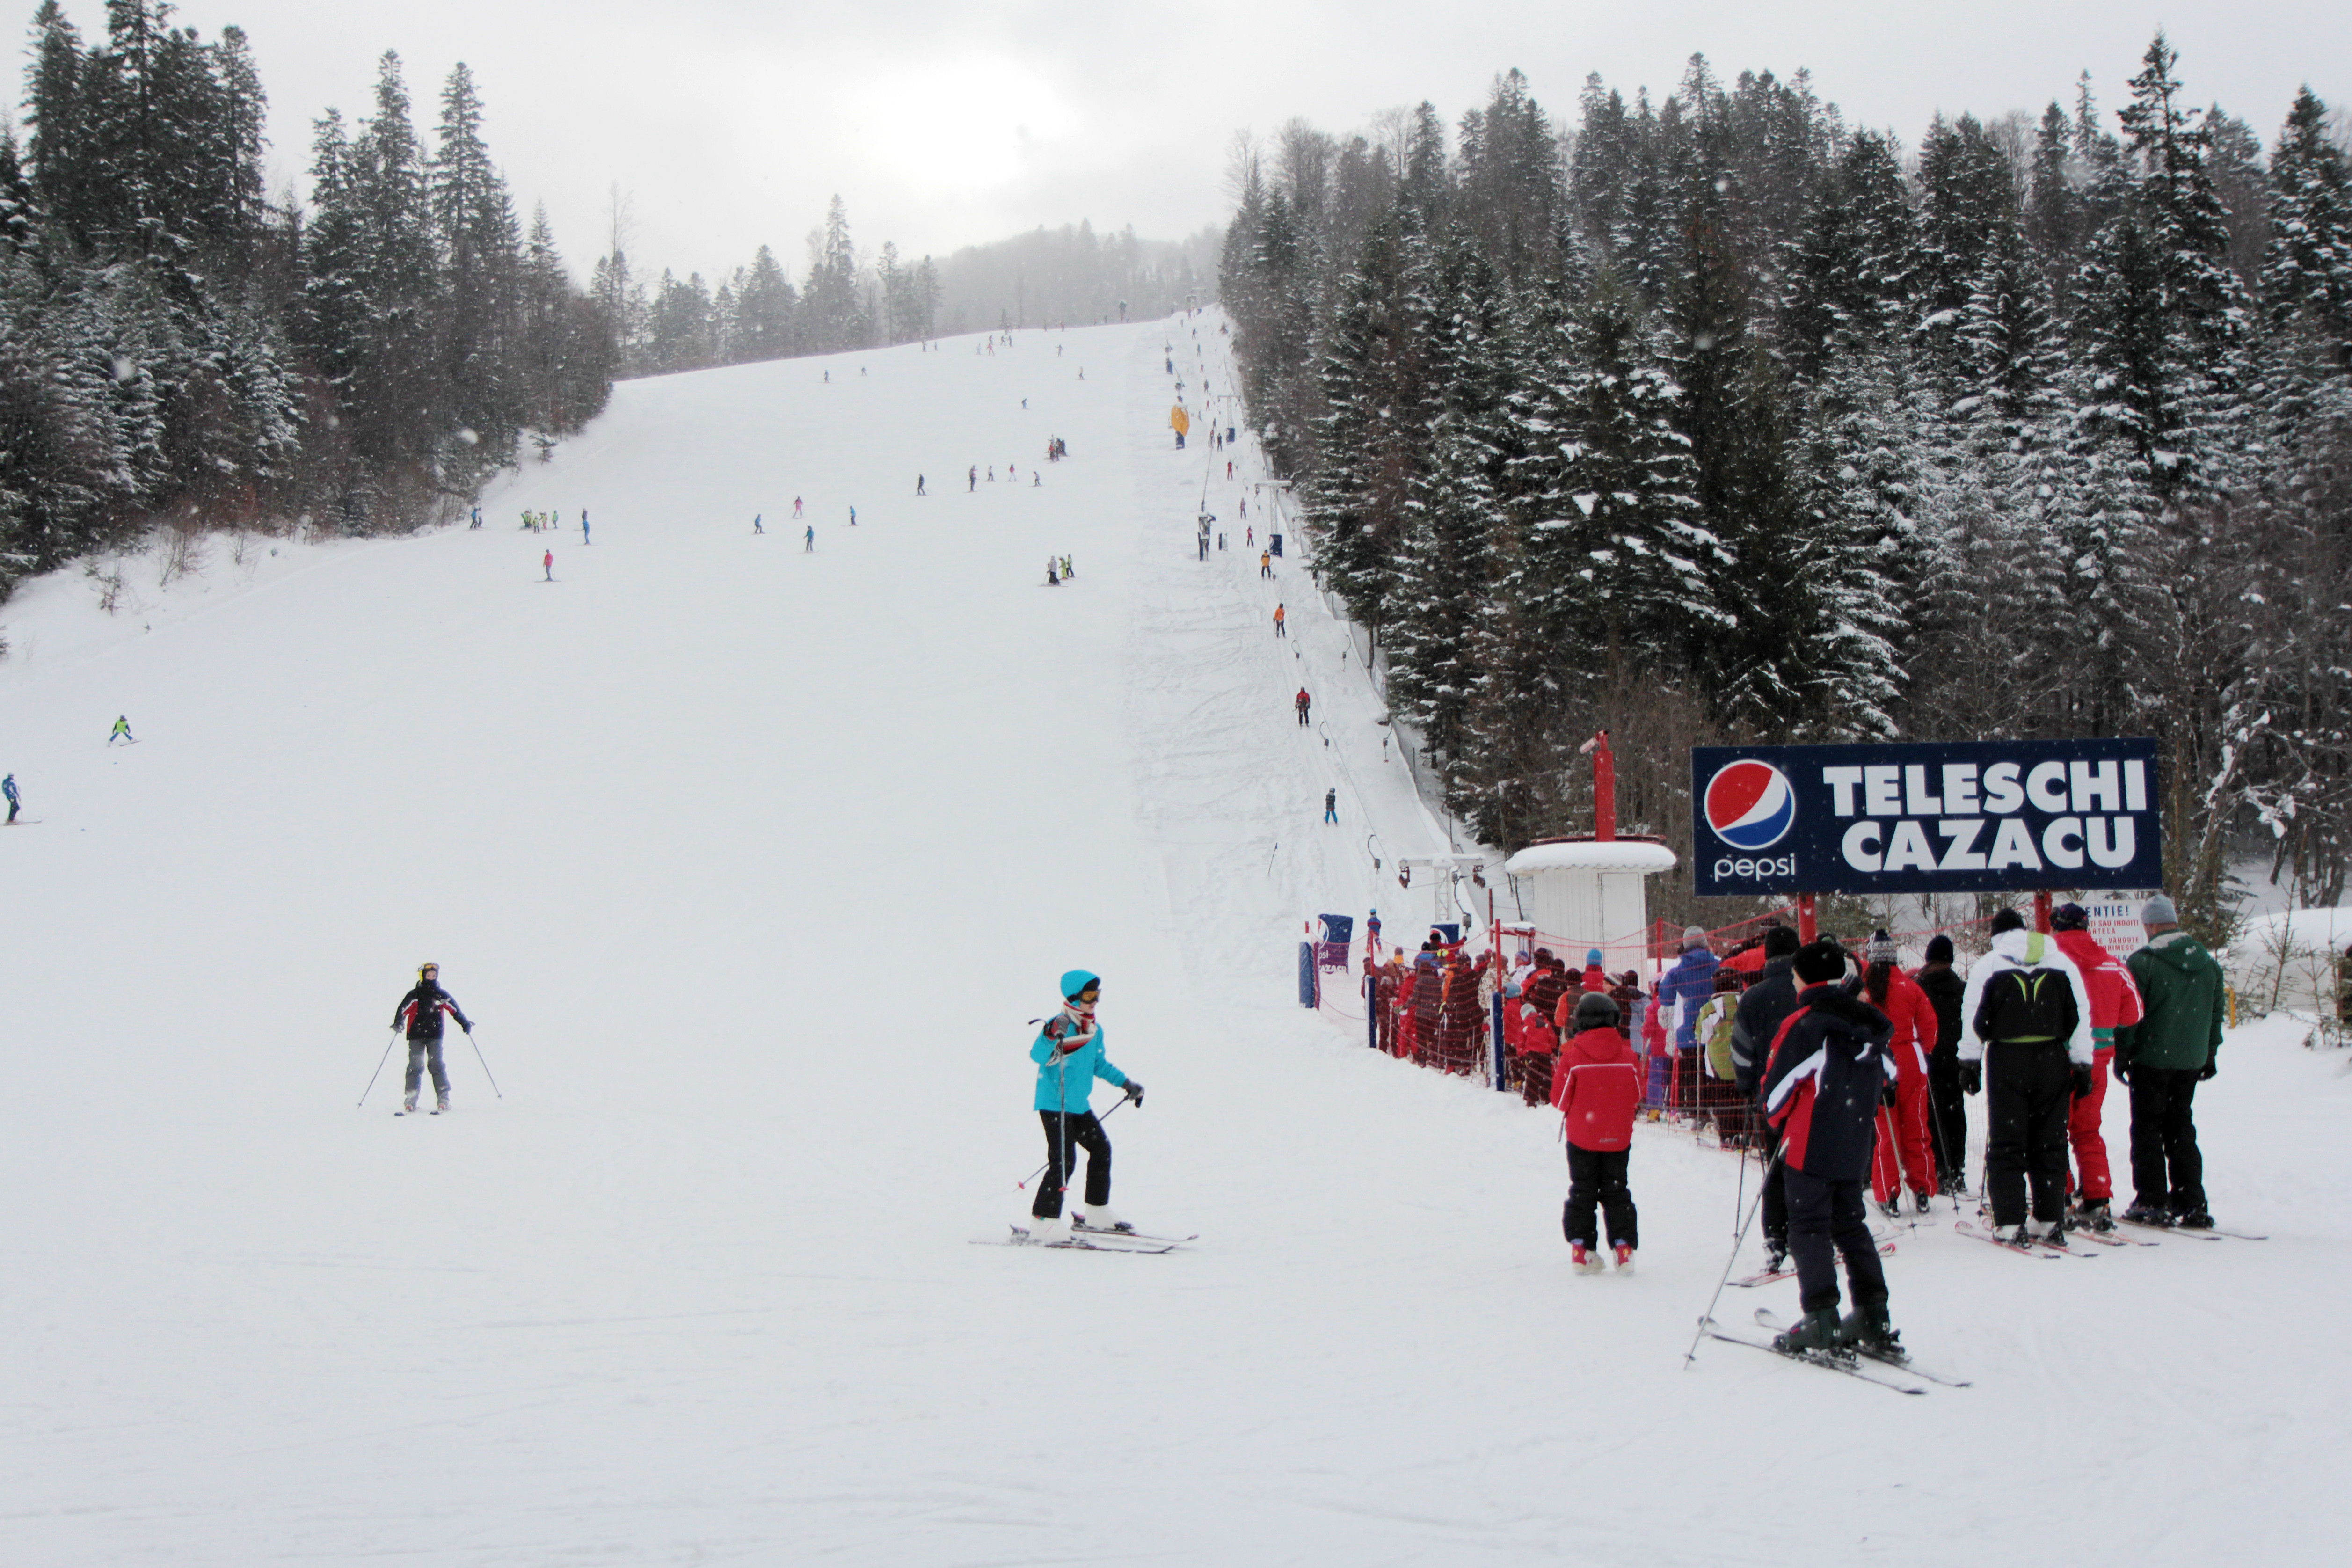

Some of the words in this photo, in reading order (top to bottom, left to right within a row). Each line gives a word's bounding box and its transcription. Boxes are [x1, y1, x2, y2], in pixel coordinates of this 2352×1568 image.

[1823, 760, 2147, 816] TELESCHI
[1842, 816, 2135, 872] CAZACU
[1714, 853, 1795, 882] pepsi
[2085, 905, 2128, 918] ENȚIE!
